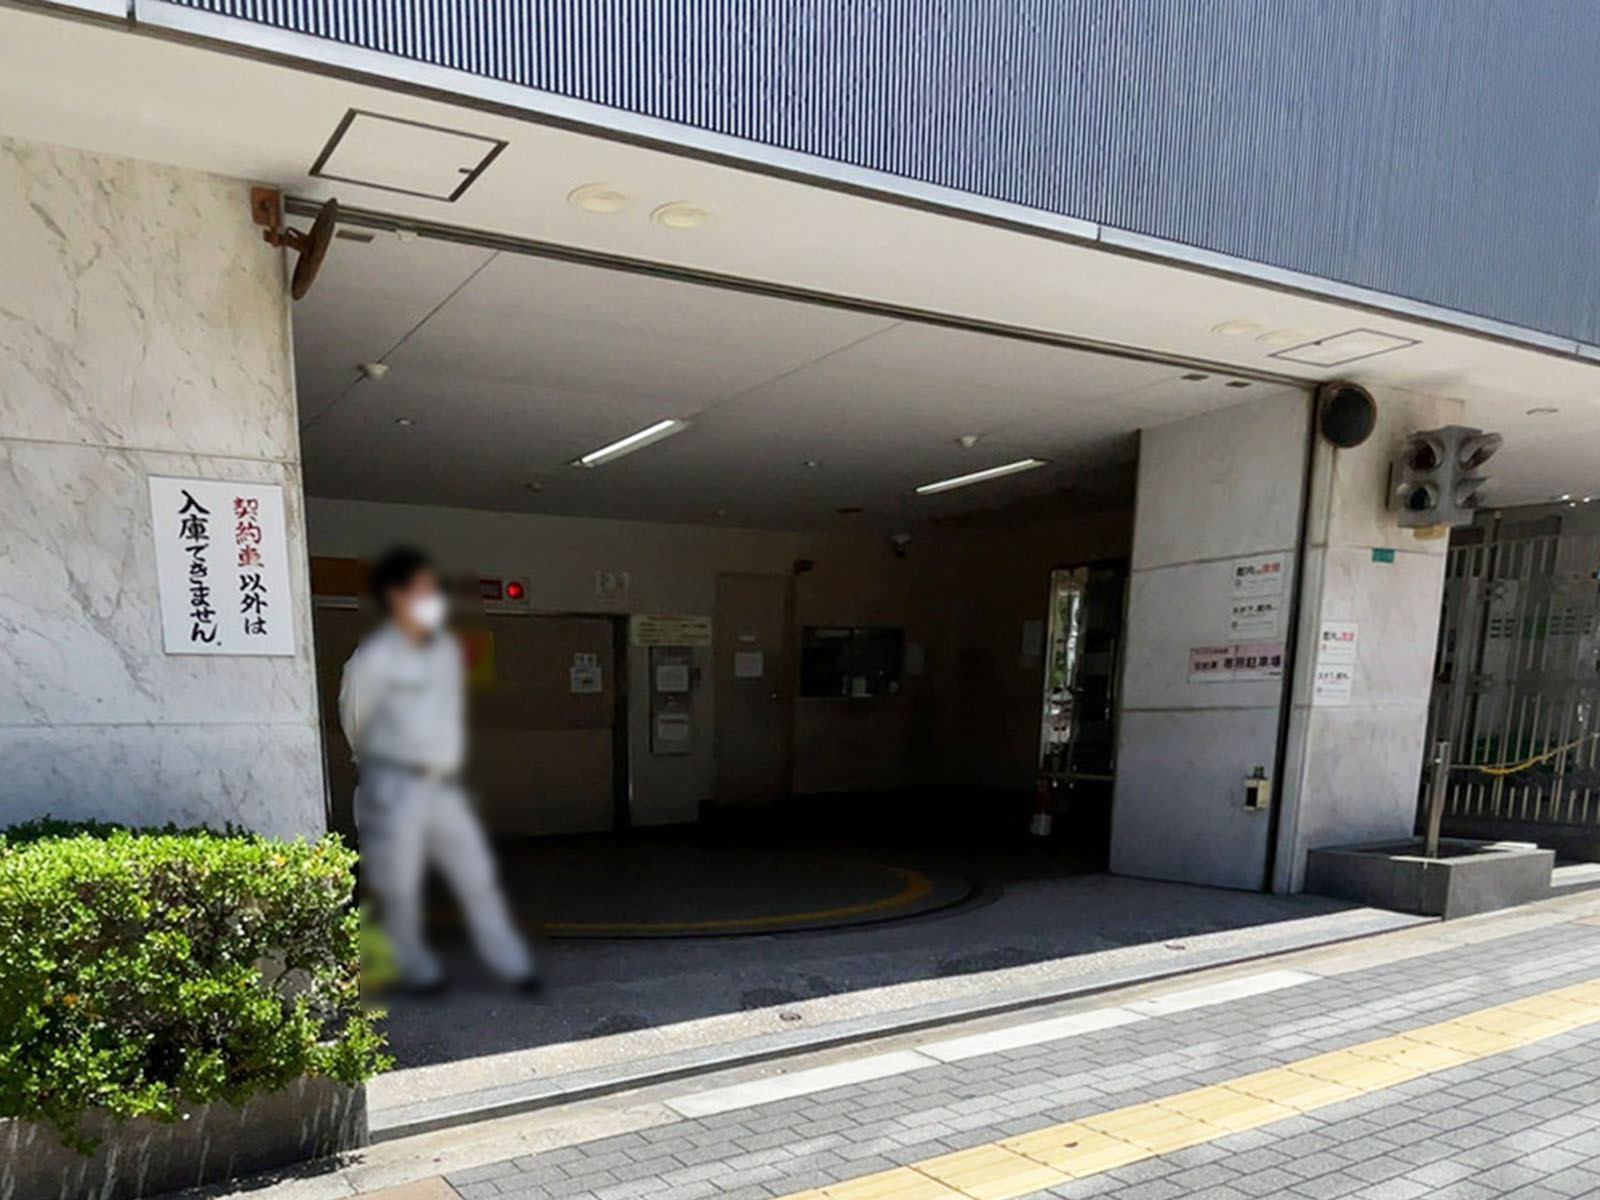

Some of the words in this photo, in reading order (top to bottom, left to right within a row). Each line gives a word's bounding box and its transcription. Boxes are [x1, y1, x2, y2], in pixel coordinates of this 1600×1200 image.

[233, 496, 268, 636] 契約車以外は
